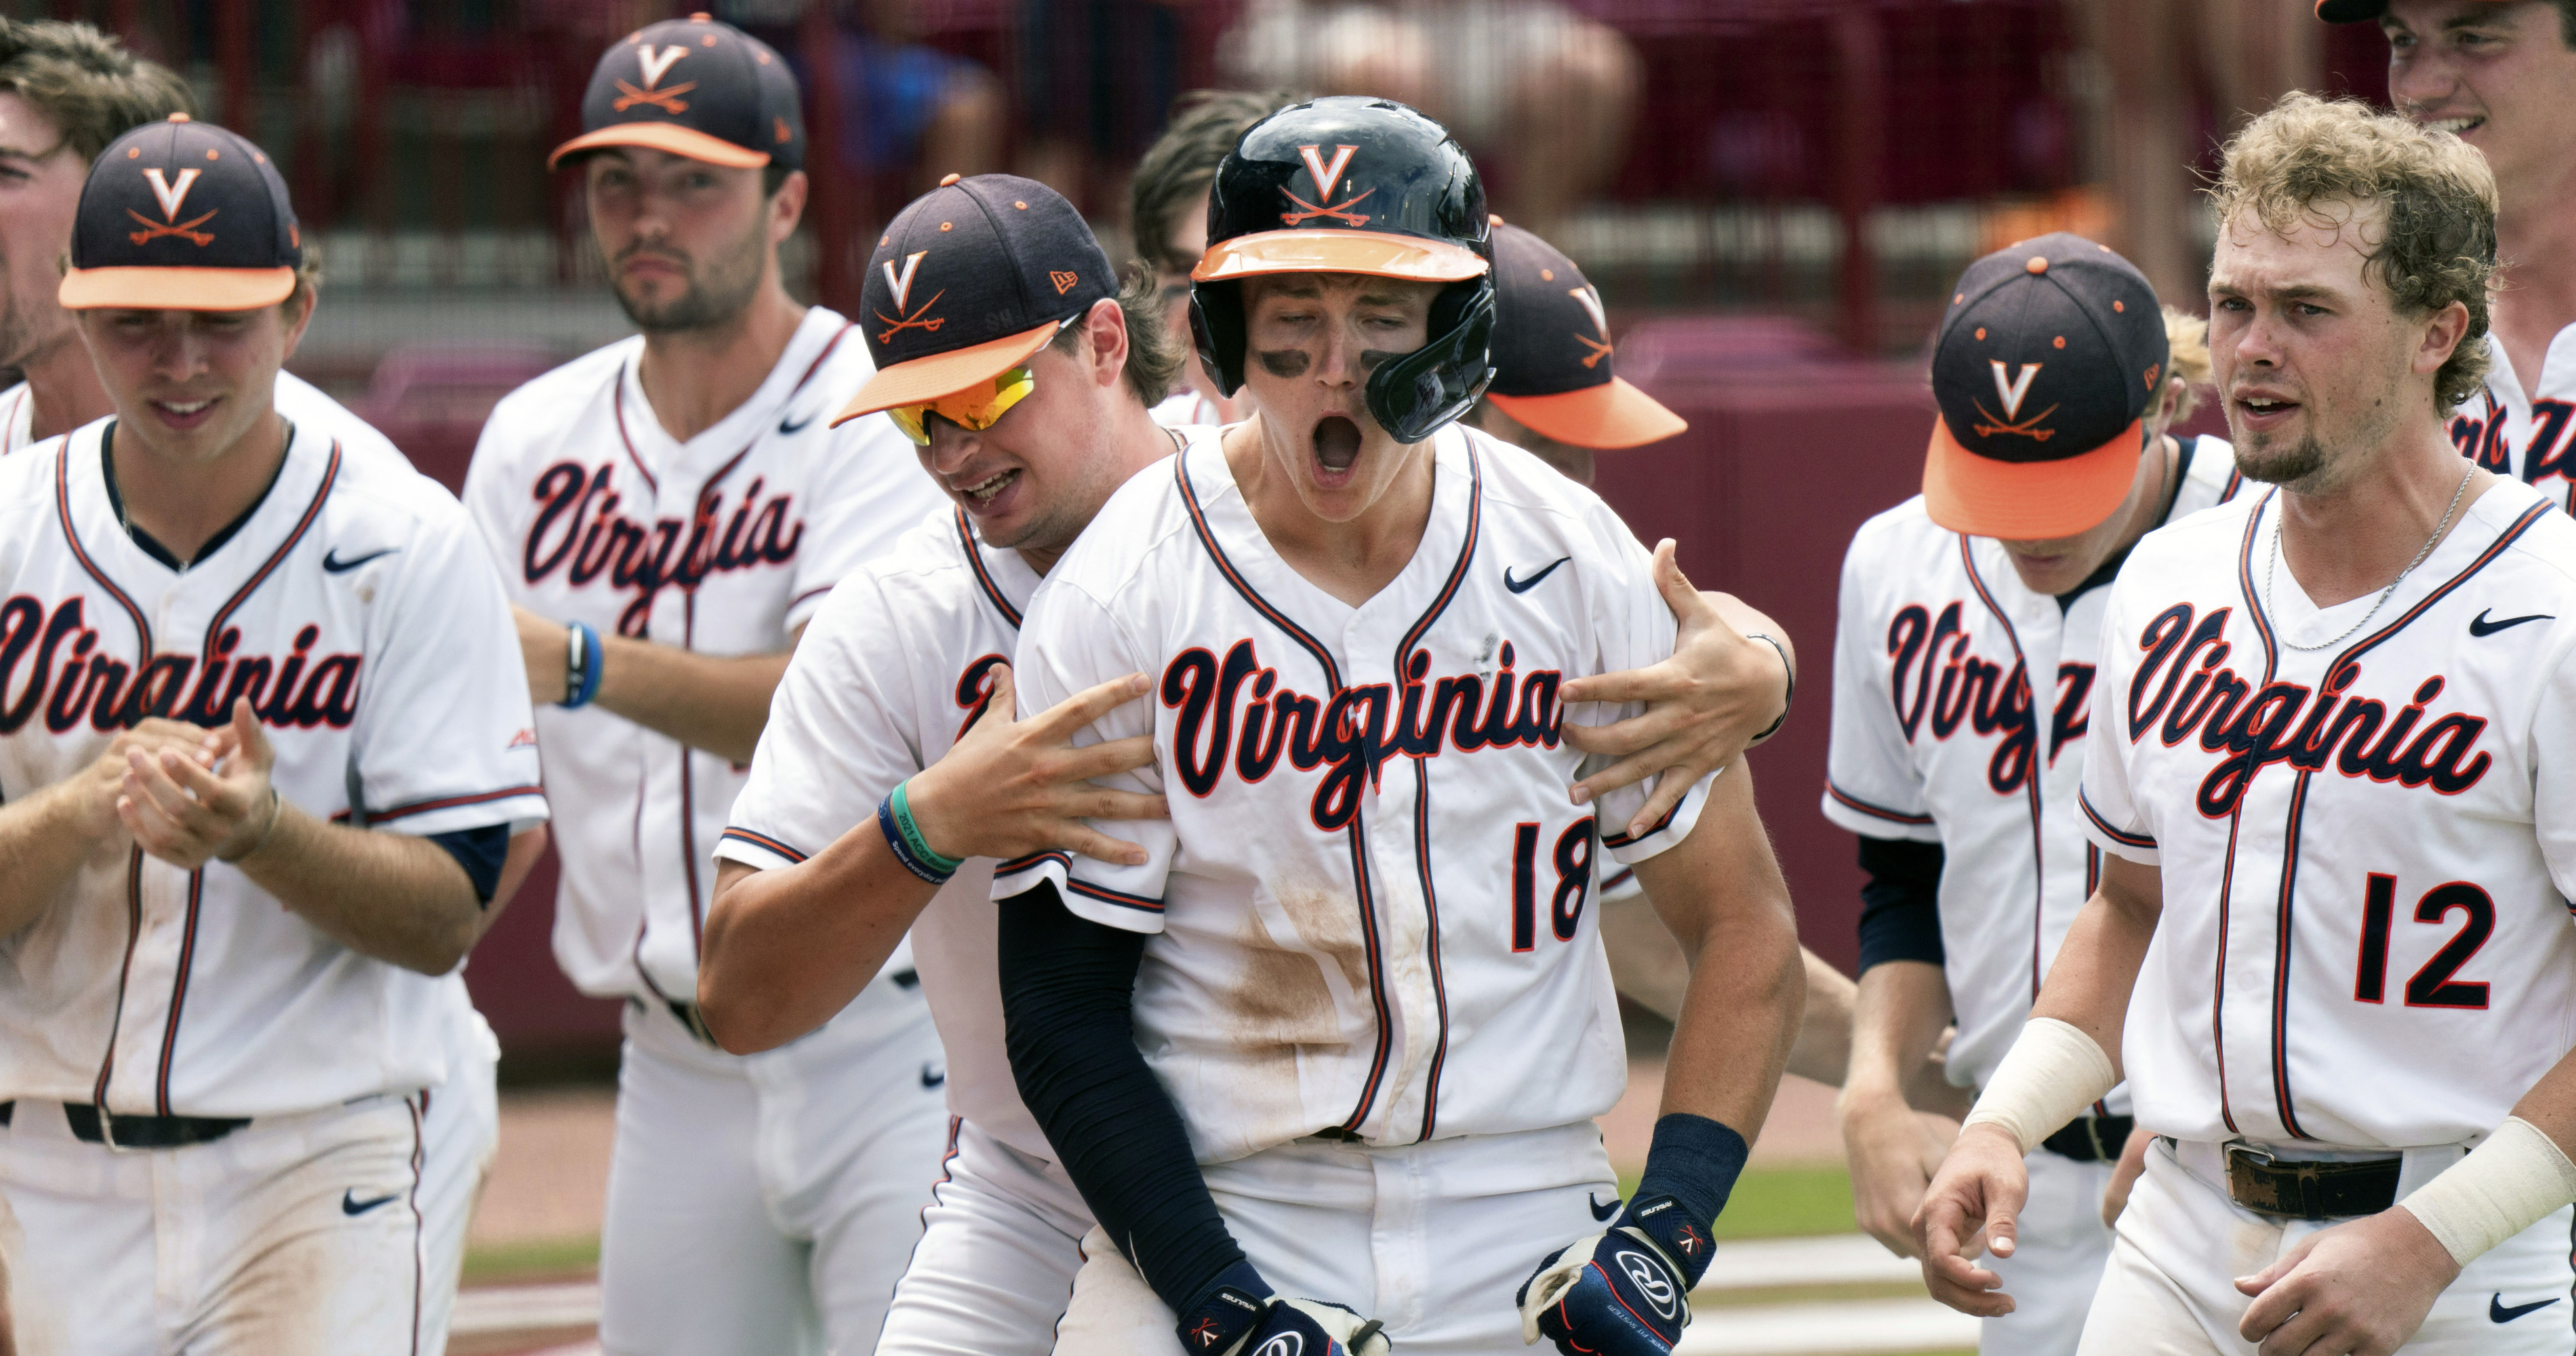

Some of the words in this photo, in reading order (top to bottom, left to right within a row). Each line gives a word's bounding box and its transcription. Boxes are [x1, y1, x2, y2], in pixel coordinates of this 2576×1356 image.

[637, 43, 690, 92] V
[142, 167, 202, 224] V
[1297, 144, 1360, 204] V
[883, 250, 928, 317] V
[1990, 359, 2043, 423] V
[1160, 638, 1564, 832] Virginia
[2127, 601, 2493, 819] Virginia
[892, 840, 910, 862] Spend
[907, 861, 935, 882] everyday
[899, 812, 914, 837] 2021
[910, 838, 929, 859] ACC
[1512, 816, 1596, 953] 18
[2354, 871, 2496, 1010] 12
[1641, 1200, 1672, 1217] RAWLINGS
[1221, 1292, 1257, 1312] RAWLINGS
[1607, 1304, 1638, 1330] SYSTEM
[1636, 1328, 1649, 1338] FIT
